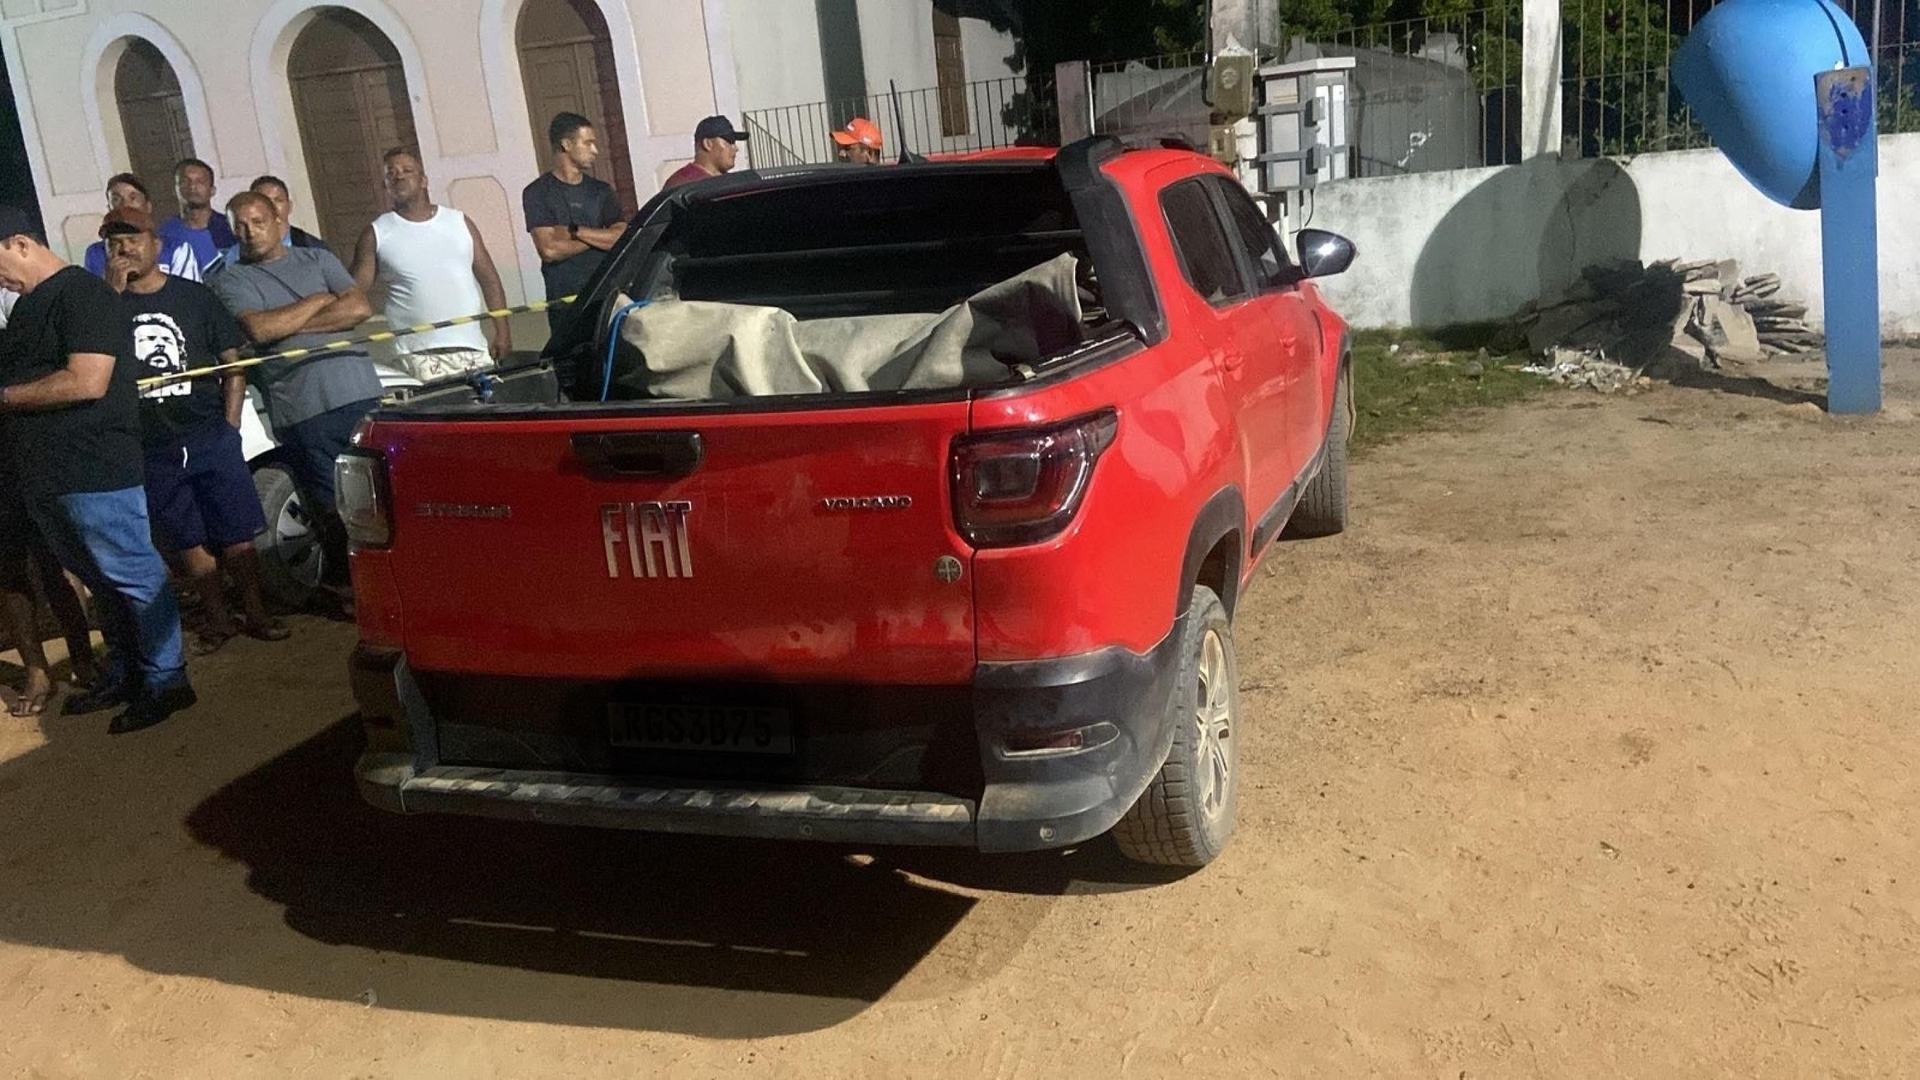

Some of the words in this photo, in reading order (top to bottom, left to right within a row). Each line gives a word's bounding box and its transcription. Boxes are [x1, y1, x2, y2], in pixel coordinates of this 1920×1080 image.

[823, 495, 912, 509] VOLCANO
[600, 501, 693, 578] FIAT
[624, 706, 772, 747] RGS3B75
